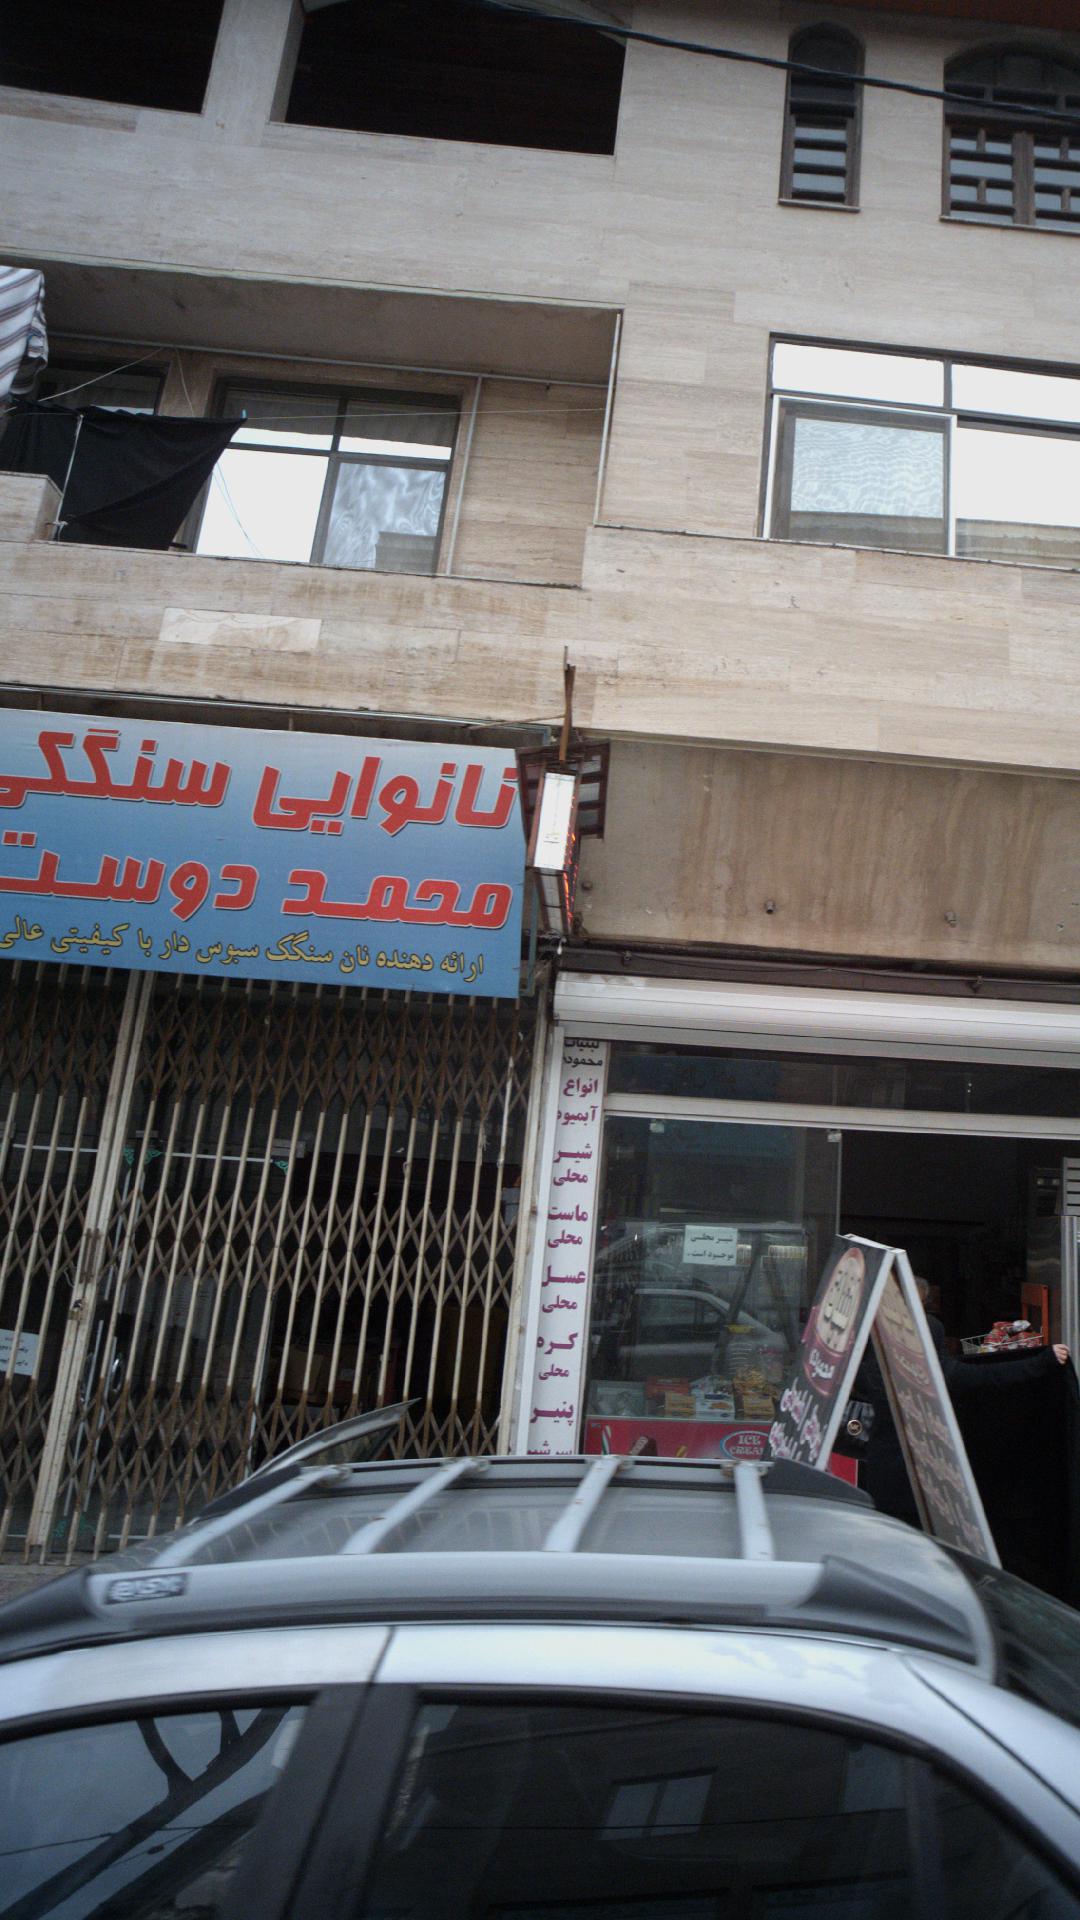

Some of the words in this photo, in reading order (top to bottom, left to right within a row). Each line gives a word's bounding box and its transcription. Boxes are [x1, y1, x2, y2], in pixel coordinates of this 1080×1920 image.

[253, 755, 518, 836] نانوایی
[0, 830, 260, 921] دوست
[281, 868, 514, 930] محمد
[0, 914, 44, 949] عالی
[51, 922, 130, 955] کیفیتی
[137, 927, 153, 958] با
[158, 930, 191, 959] دار
[195, 940, 259, 965] سبوس
[265, 930, 334, 963] سنگک
[339, 944, 370, 974] نان
[376, 949, 435, 971] دهنده
[441, 951, 484, 982] ارائه
[562, 1077, 599, 1098] انواع
[553, 1143, 593, 1164] شیر
[553, 1168, 588, 1187] محلی
[547, 1204, 589, 1223] ماست
[547, 1230, 583, 1248] محلی
[541, 1265, 586, 1288] عسل
[541, 1295, 578, 1313] محلی
[536, 1332, 579, 1355] کره
[538, 1363, 570, 1380] محلی
[530, 1400, 574, 1426] پنیر
[738, 1435, 761, 1445] ICE
